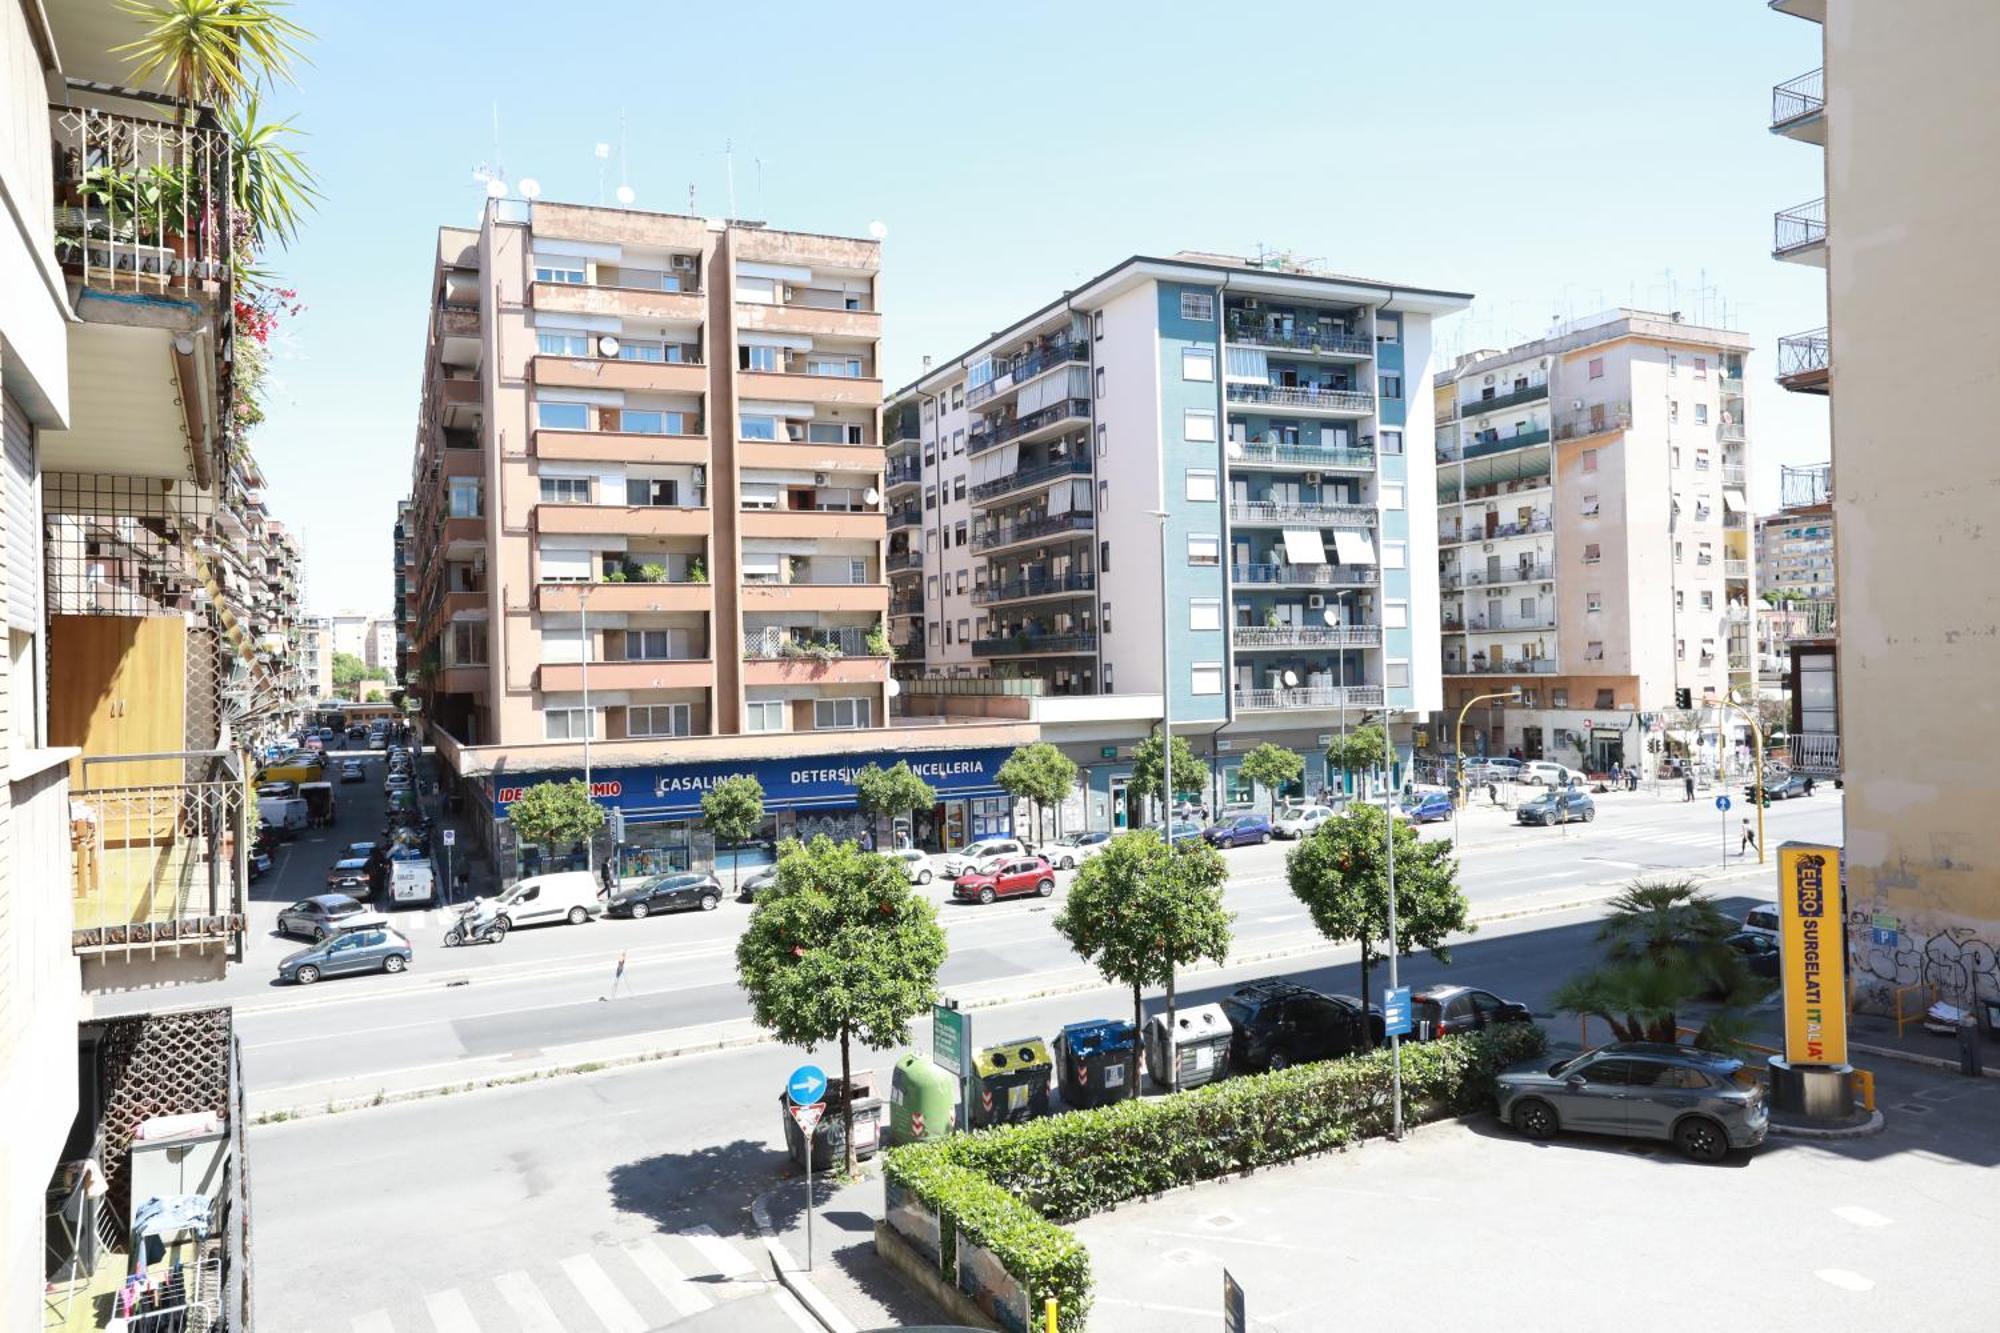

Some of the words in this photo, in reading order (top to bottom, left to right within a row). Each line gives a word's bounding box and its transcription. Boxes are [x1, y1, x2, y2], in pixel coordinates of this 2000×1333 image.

[1802, 868, 1818, 912] EURO
[1803, 920, 1821, 1004] SURGELATI
[1806, 1008, 1823, 1057] ITALIA
